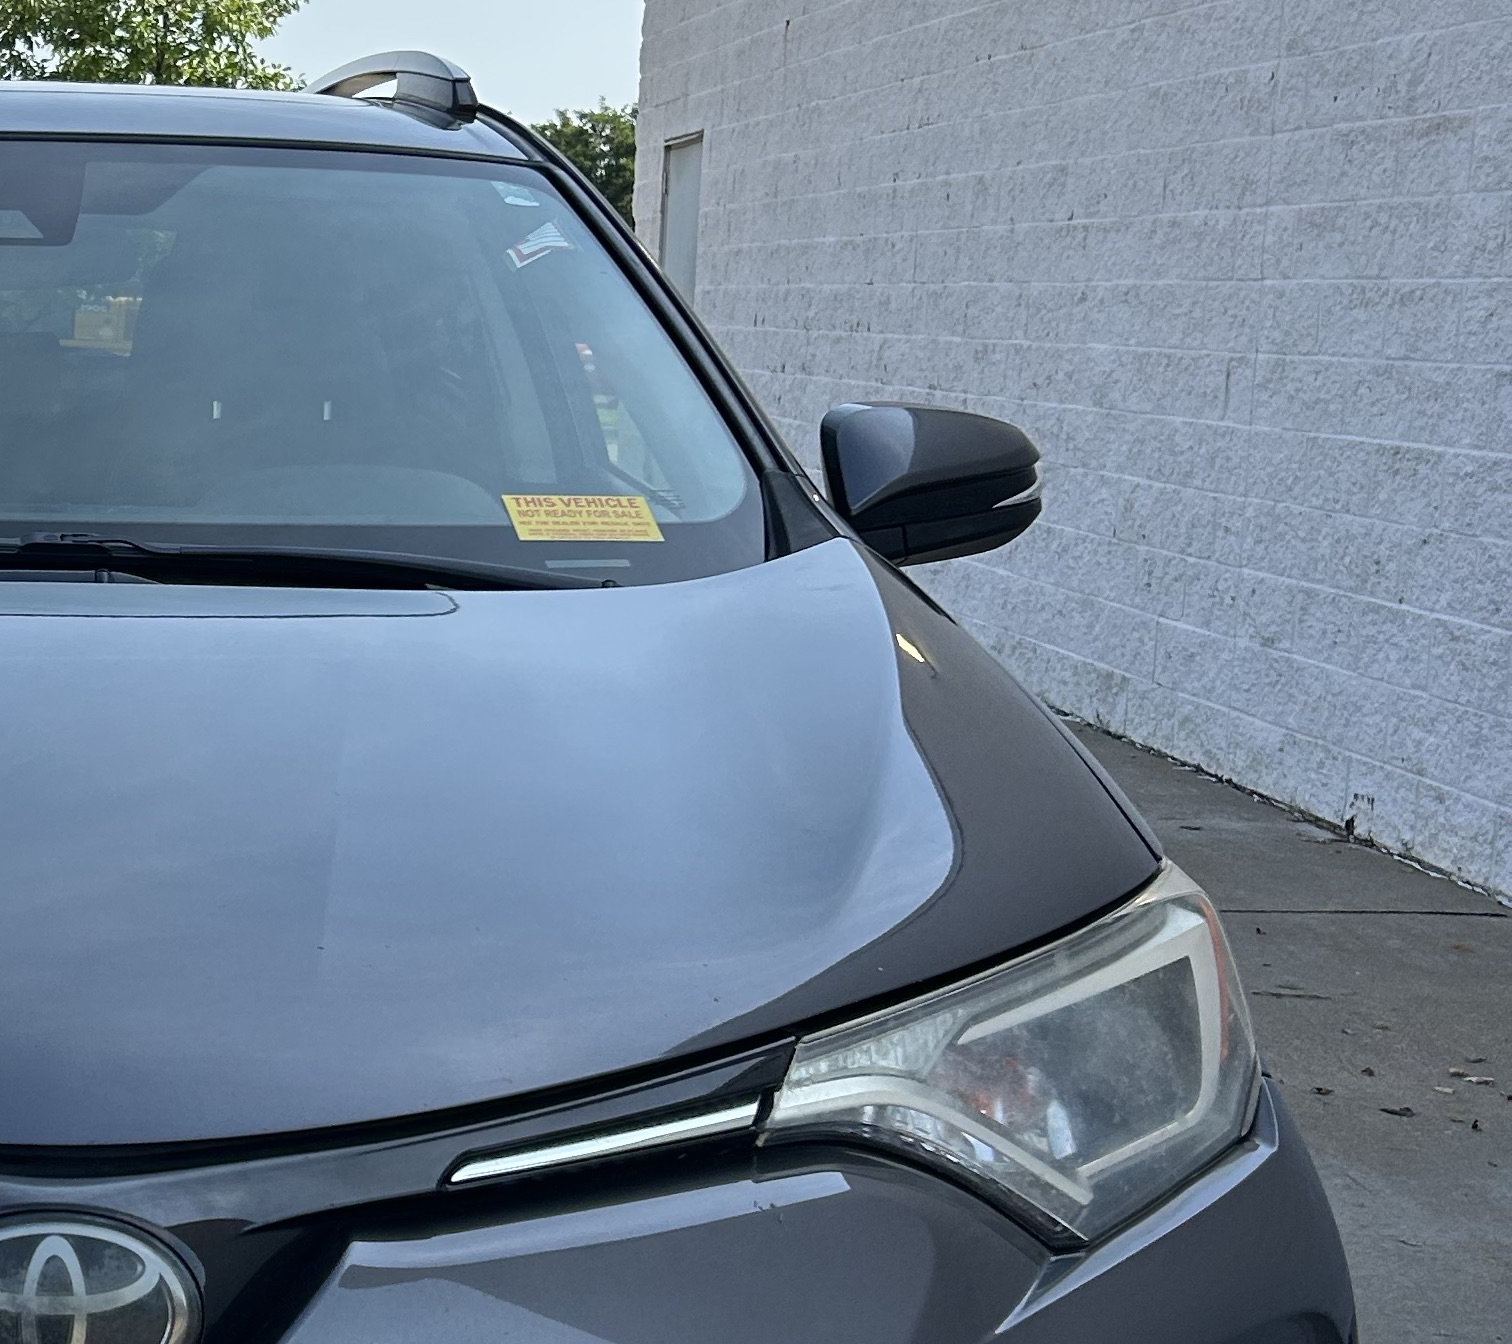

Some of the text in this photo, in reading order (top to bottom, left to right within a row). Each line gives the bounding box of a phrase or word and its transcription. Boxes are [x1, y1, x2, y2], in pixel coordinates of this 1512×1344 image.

[511, 496, 641, 509] THIS VEHICLE
[516, 509, 644, 519] NOT READY FOR SALE
